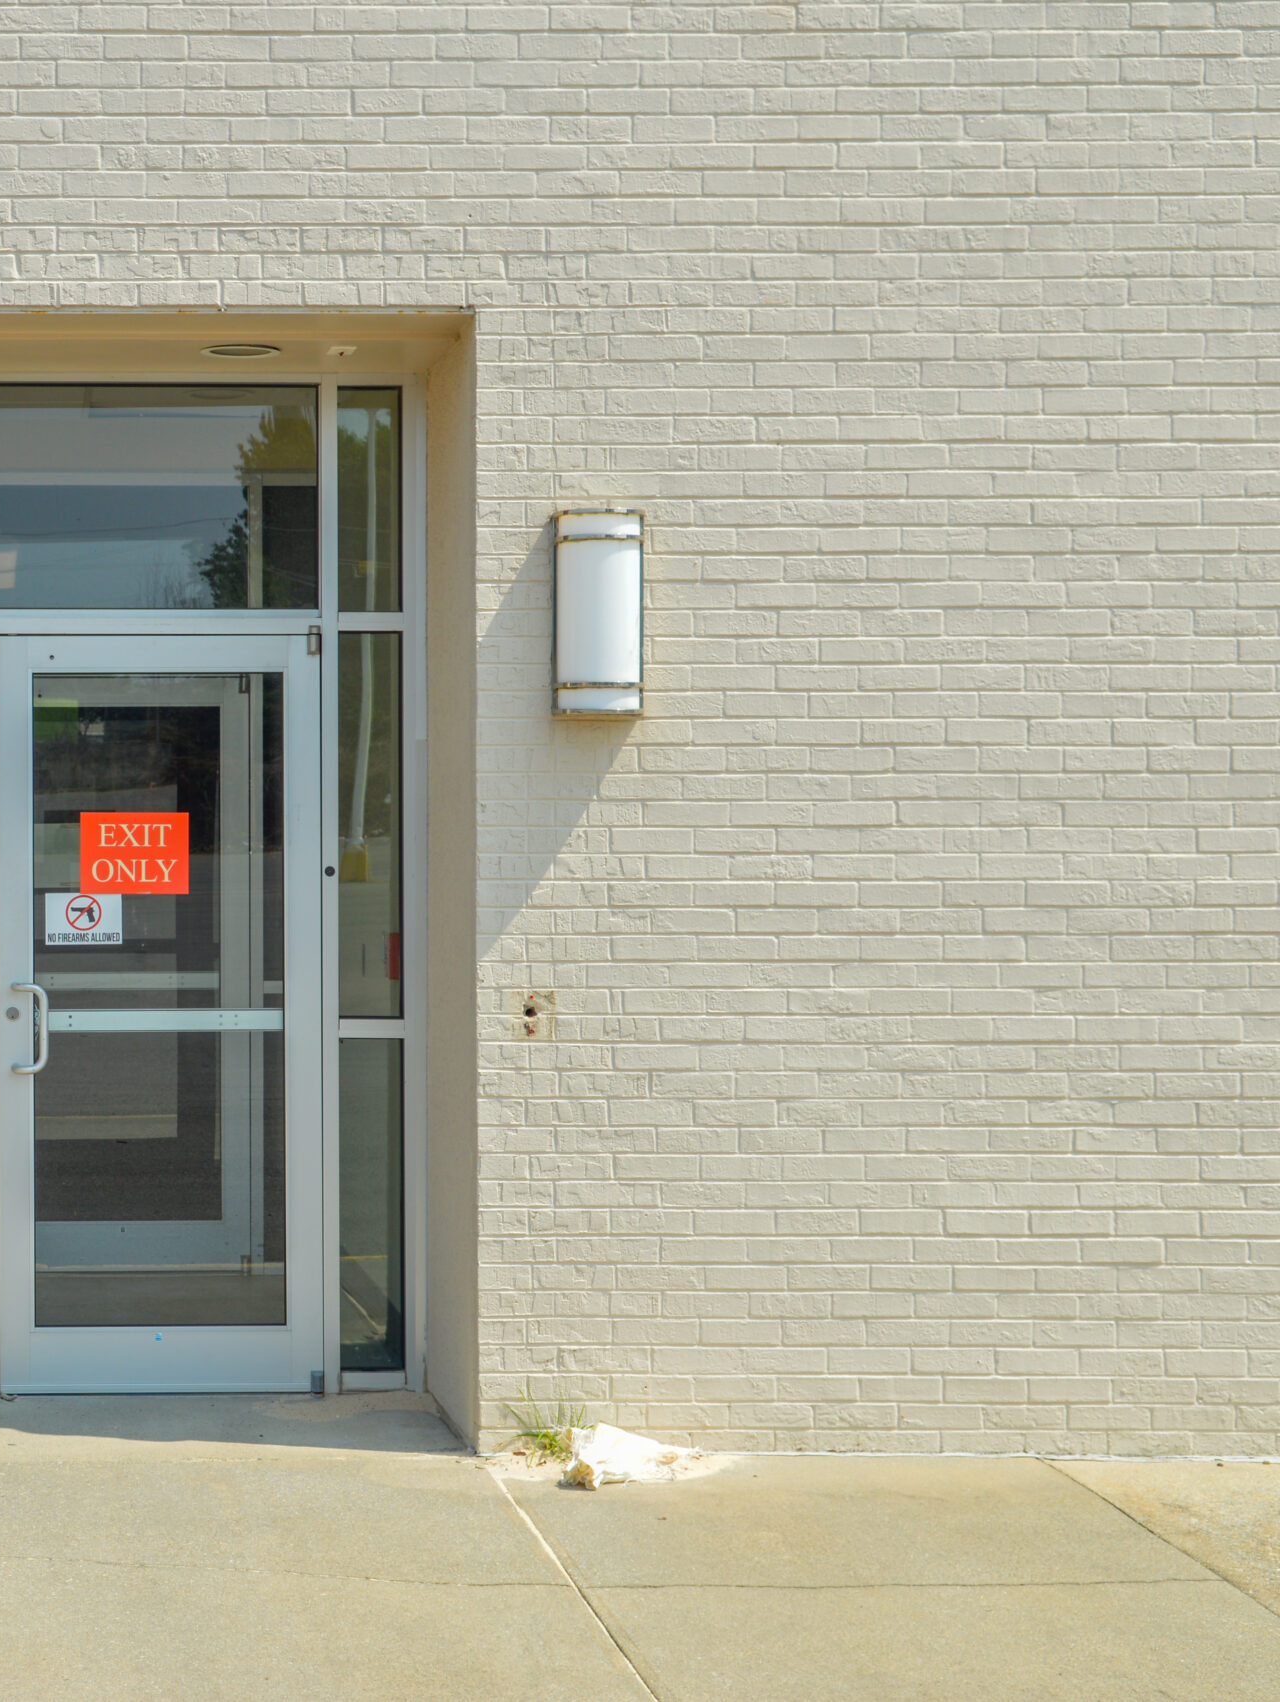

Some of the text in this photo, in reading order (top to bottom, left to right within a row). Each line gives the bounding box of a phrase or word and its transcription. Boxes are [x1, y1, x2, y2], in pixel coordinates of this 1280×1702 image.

[98, 823, 172, 847] EXIT
[91, 858, 179, 883] ONLY
[47, 932, 121, 943] NO FIREARMS ALLOWED
